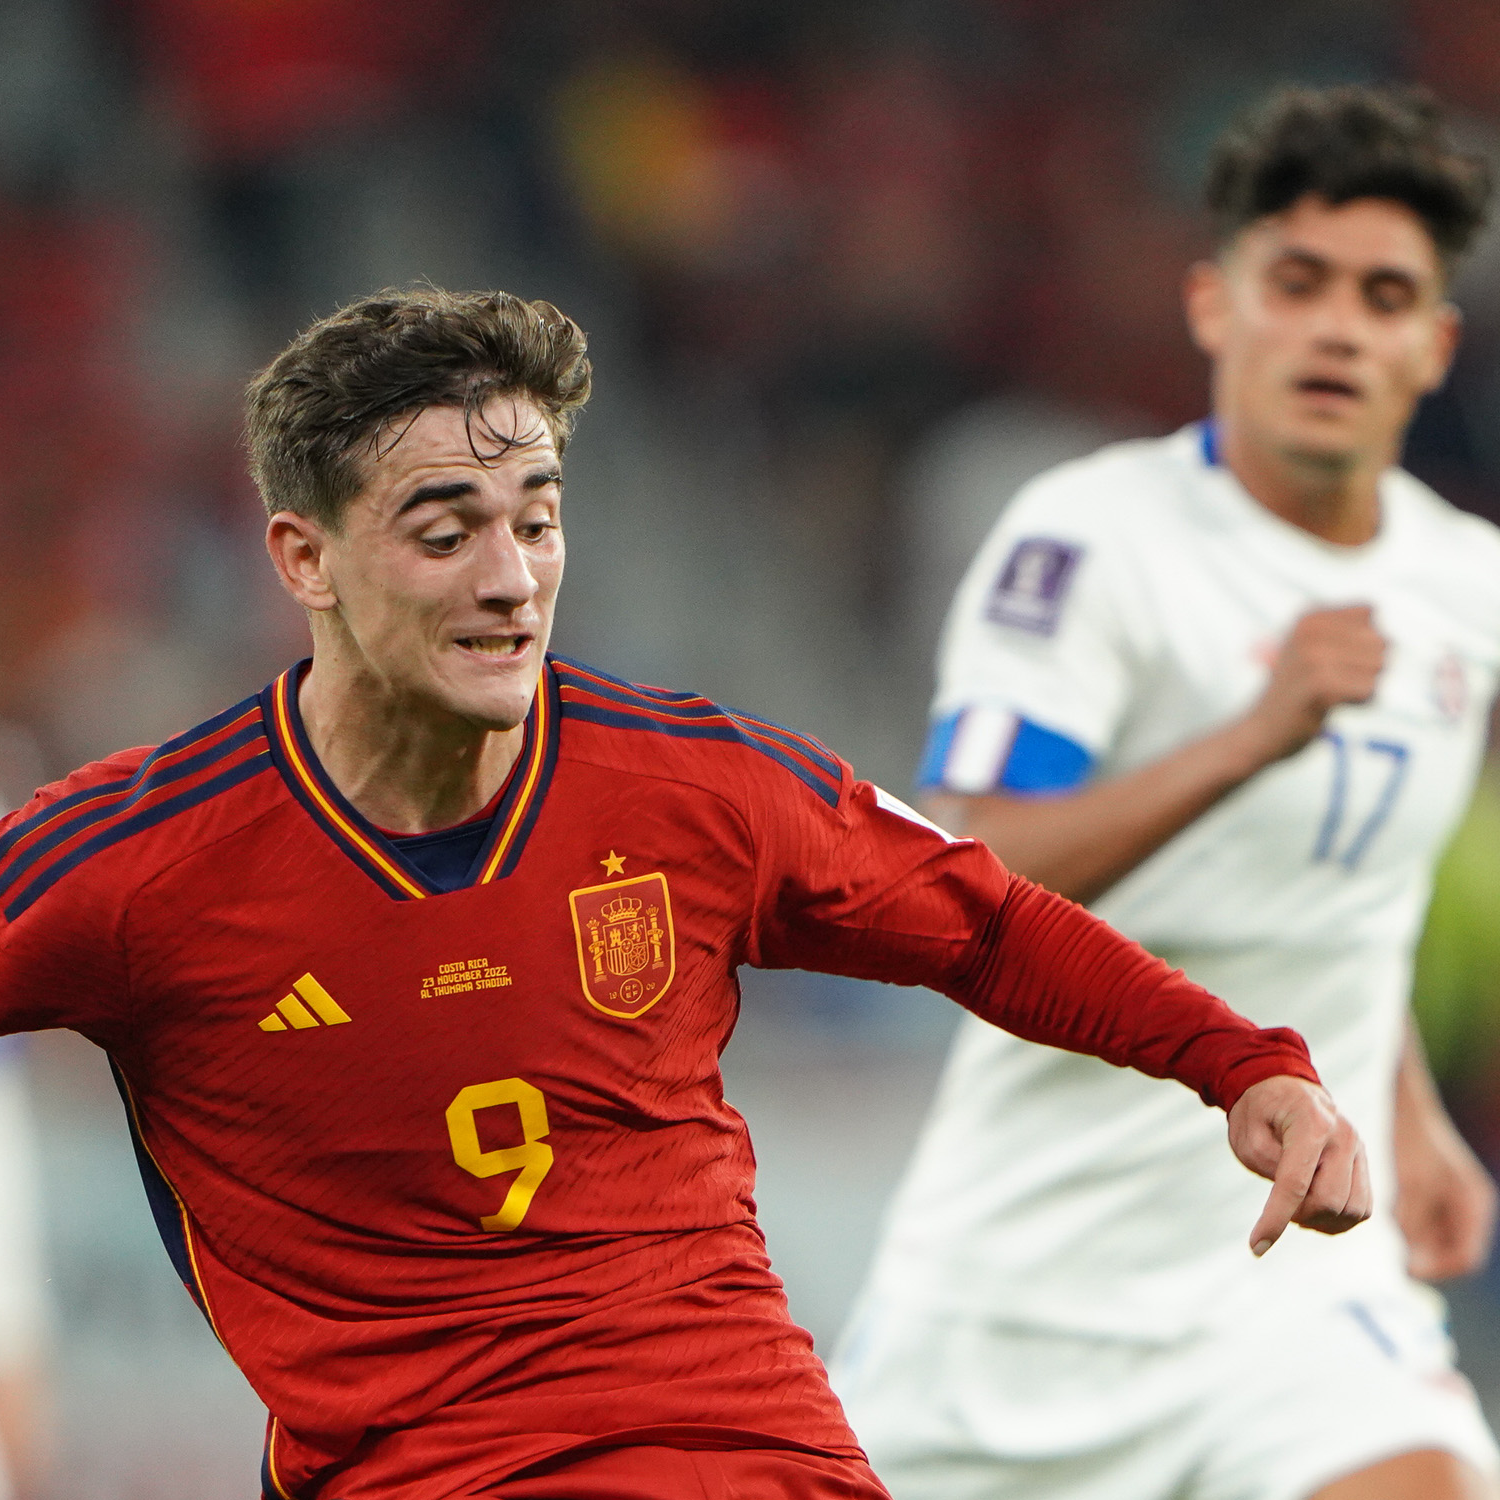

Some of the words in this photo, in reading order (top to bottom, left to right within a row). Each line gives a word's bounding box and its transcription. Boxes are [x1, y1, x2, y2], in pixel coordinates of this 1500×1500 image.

[1321, 728, 1411, 873] 17
[422, 977, 435, 988] 23
[437, 969, 482, 985] NOVEMBER
[484, 966, 508, 978] 2022
[438, 961, 465, 974] COSTA
[467, 958, 489, 970] RICA
[420, 989, 433, 999] AL
[433, 982, 474, 997] THUMAMA
[475, 976, 513, 990] STADIUM
[445, 1077, 553, 1232] 9
